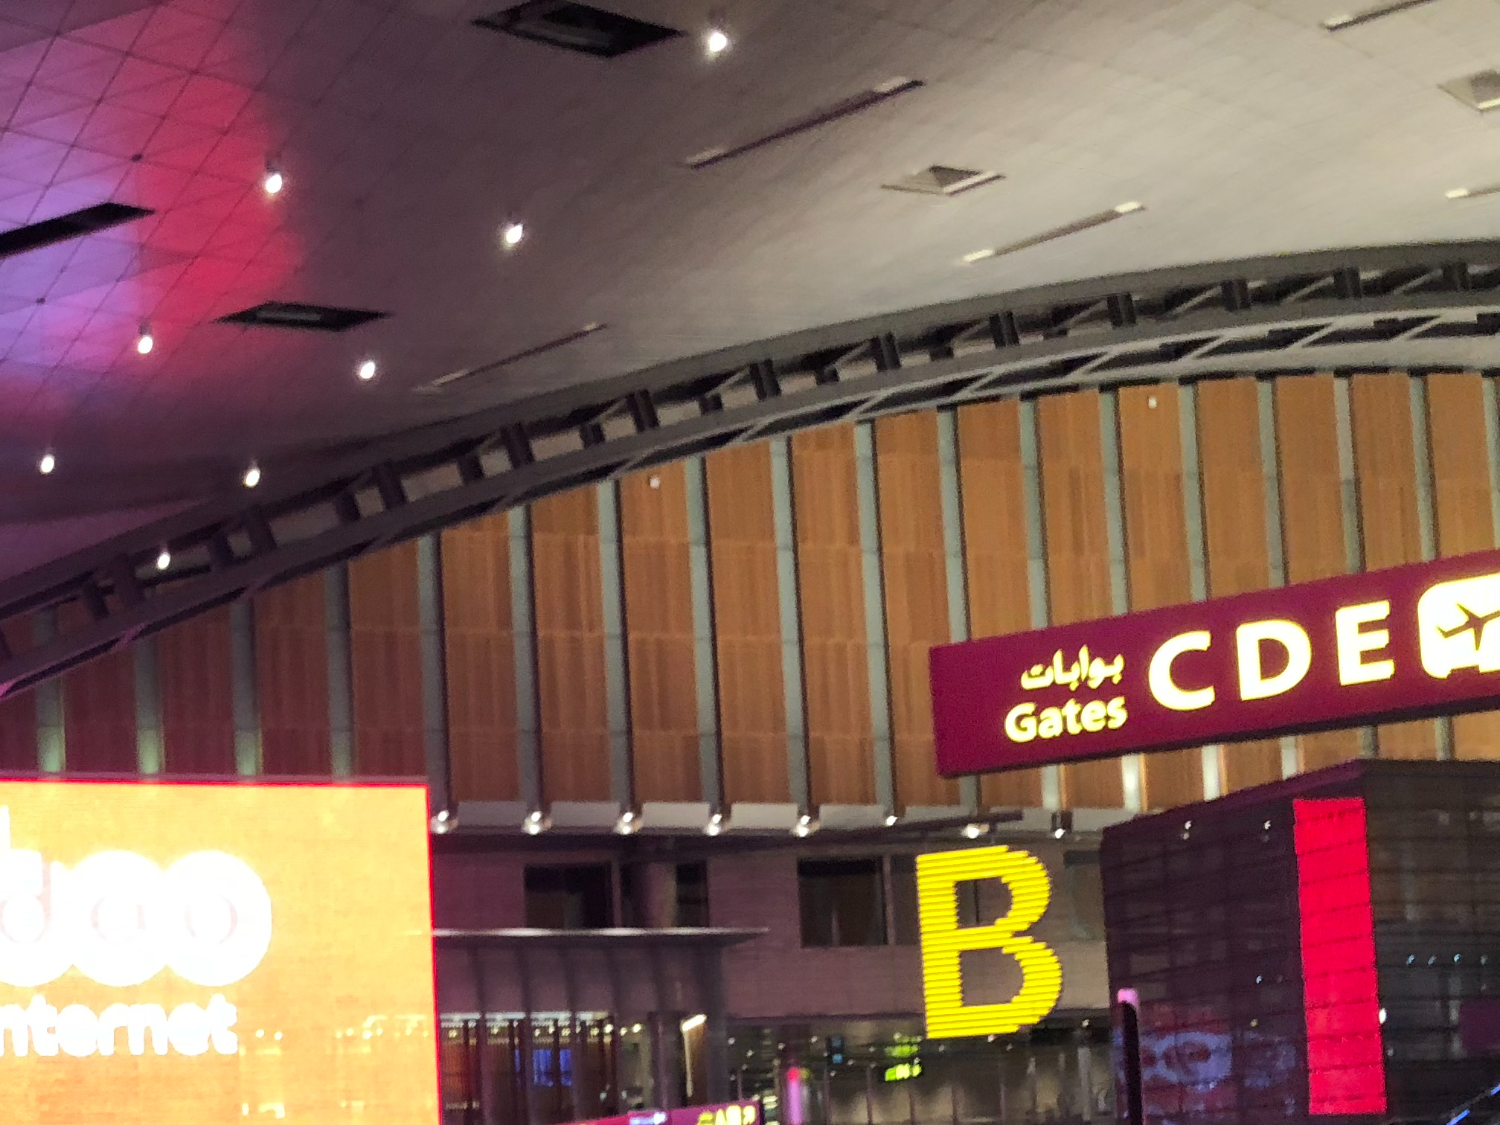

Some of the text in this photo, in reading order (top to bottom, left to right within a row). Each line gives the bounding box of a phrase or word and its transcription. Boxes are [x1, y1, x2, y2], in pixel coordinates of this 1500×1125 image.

[1020, 643, 1125, 691] بوابات
[1004, 696, 1128, 743] Gates
[916, 845, 1062, 1039] B
